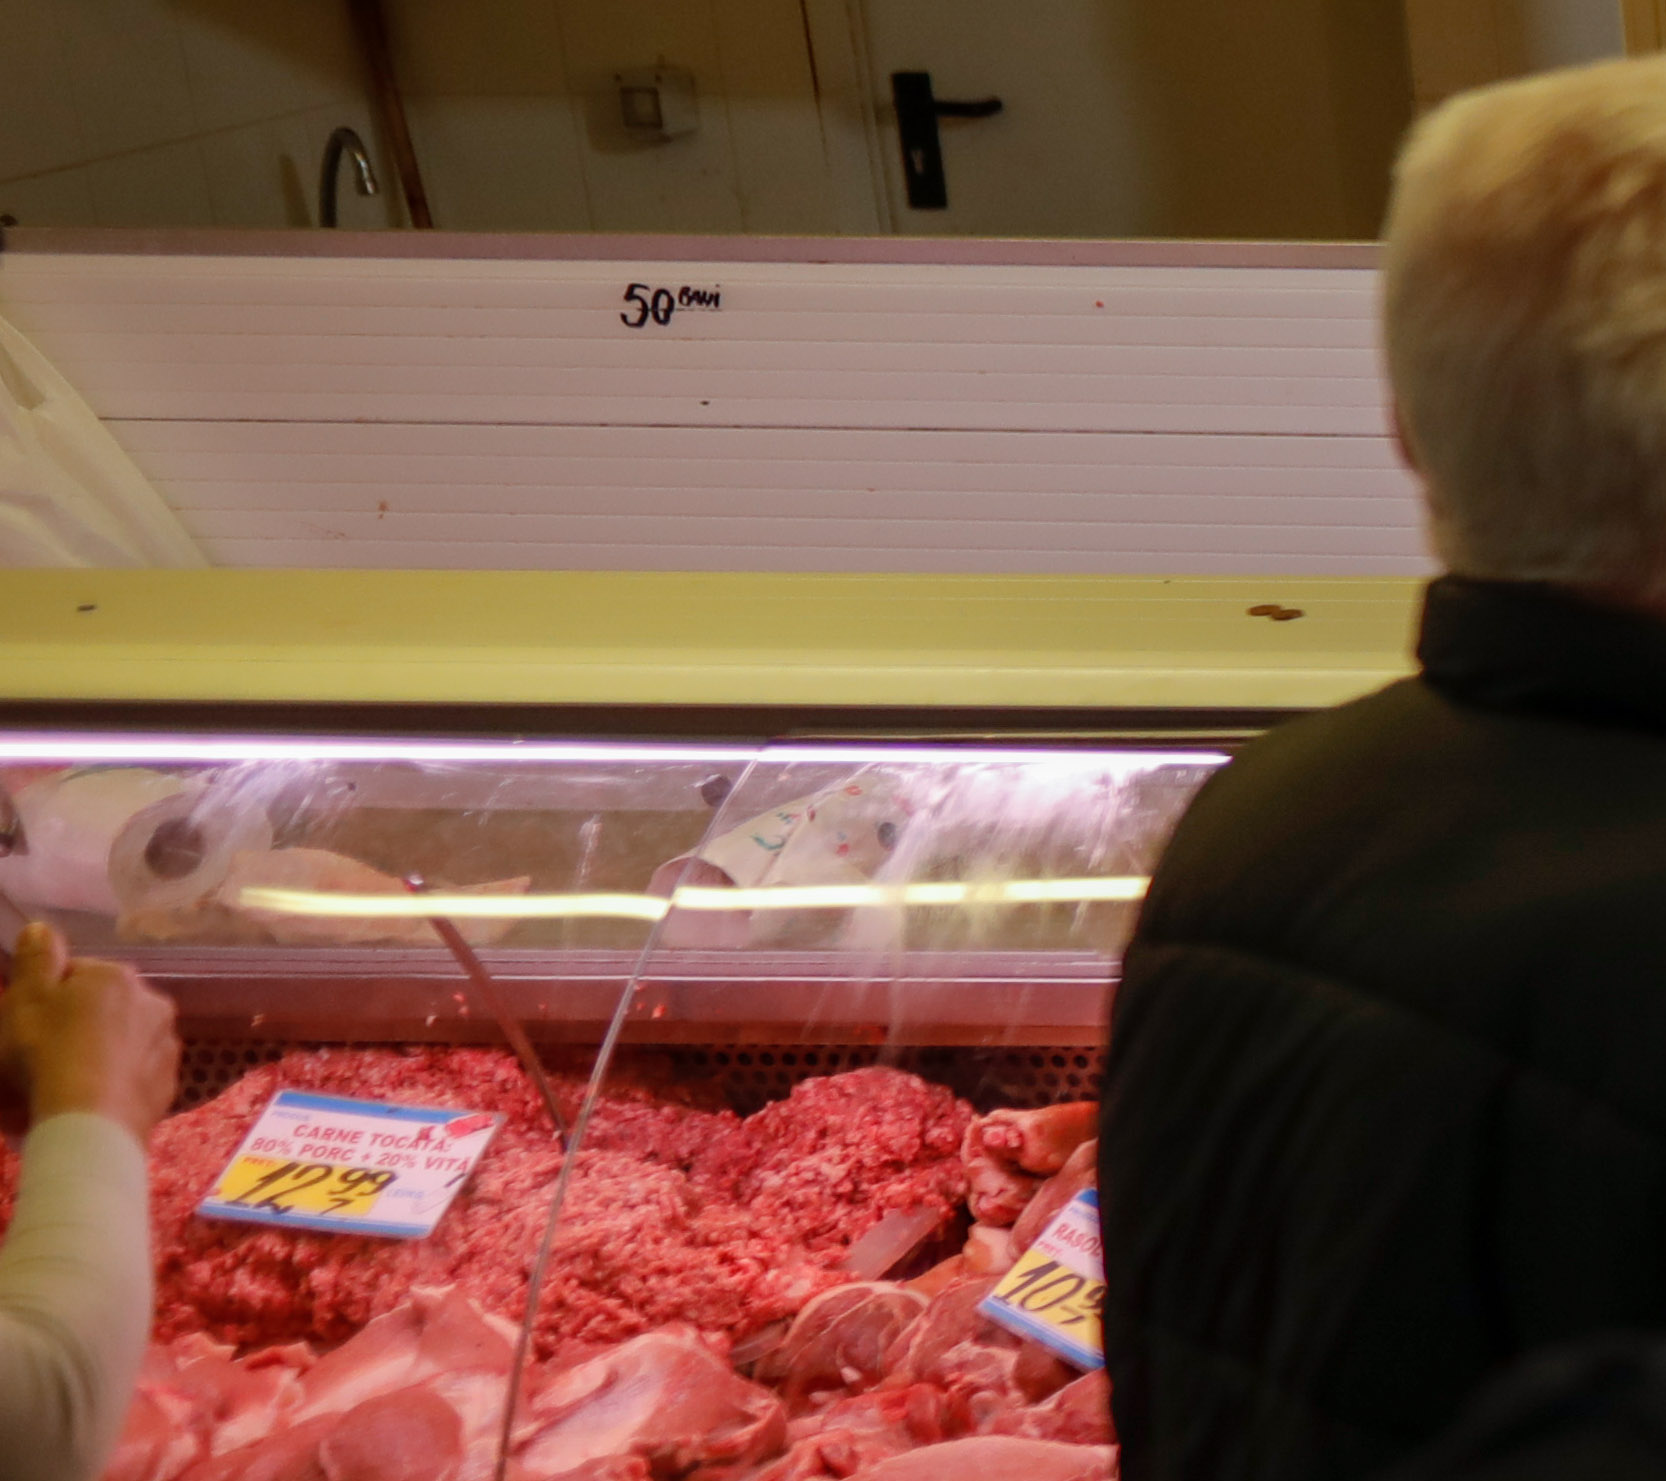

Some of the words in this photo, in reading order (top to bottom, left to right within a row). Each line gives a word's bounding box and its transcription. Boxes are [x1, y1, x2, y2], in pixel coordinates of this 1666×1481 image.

[620, 282, 676, 329] 50
[293, 1123, 364, 1145] CARNE
[249, 1137, 296, 1157] 80%
[300, 1142, 354, 1163] PORC
[378, 1151, 417, 1172] 20%
[325, 1163, 398, 1198] 99
[992, 1260, 1086, 1312] 10
